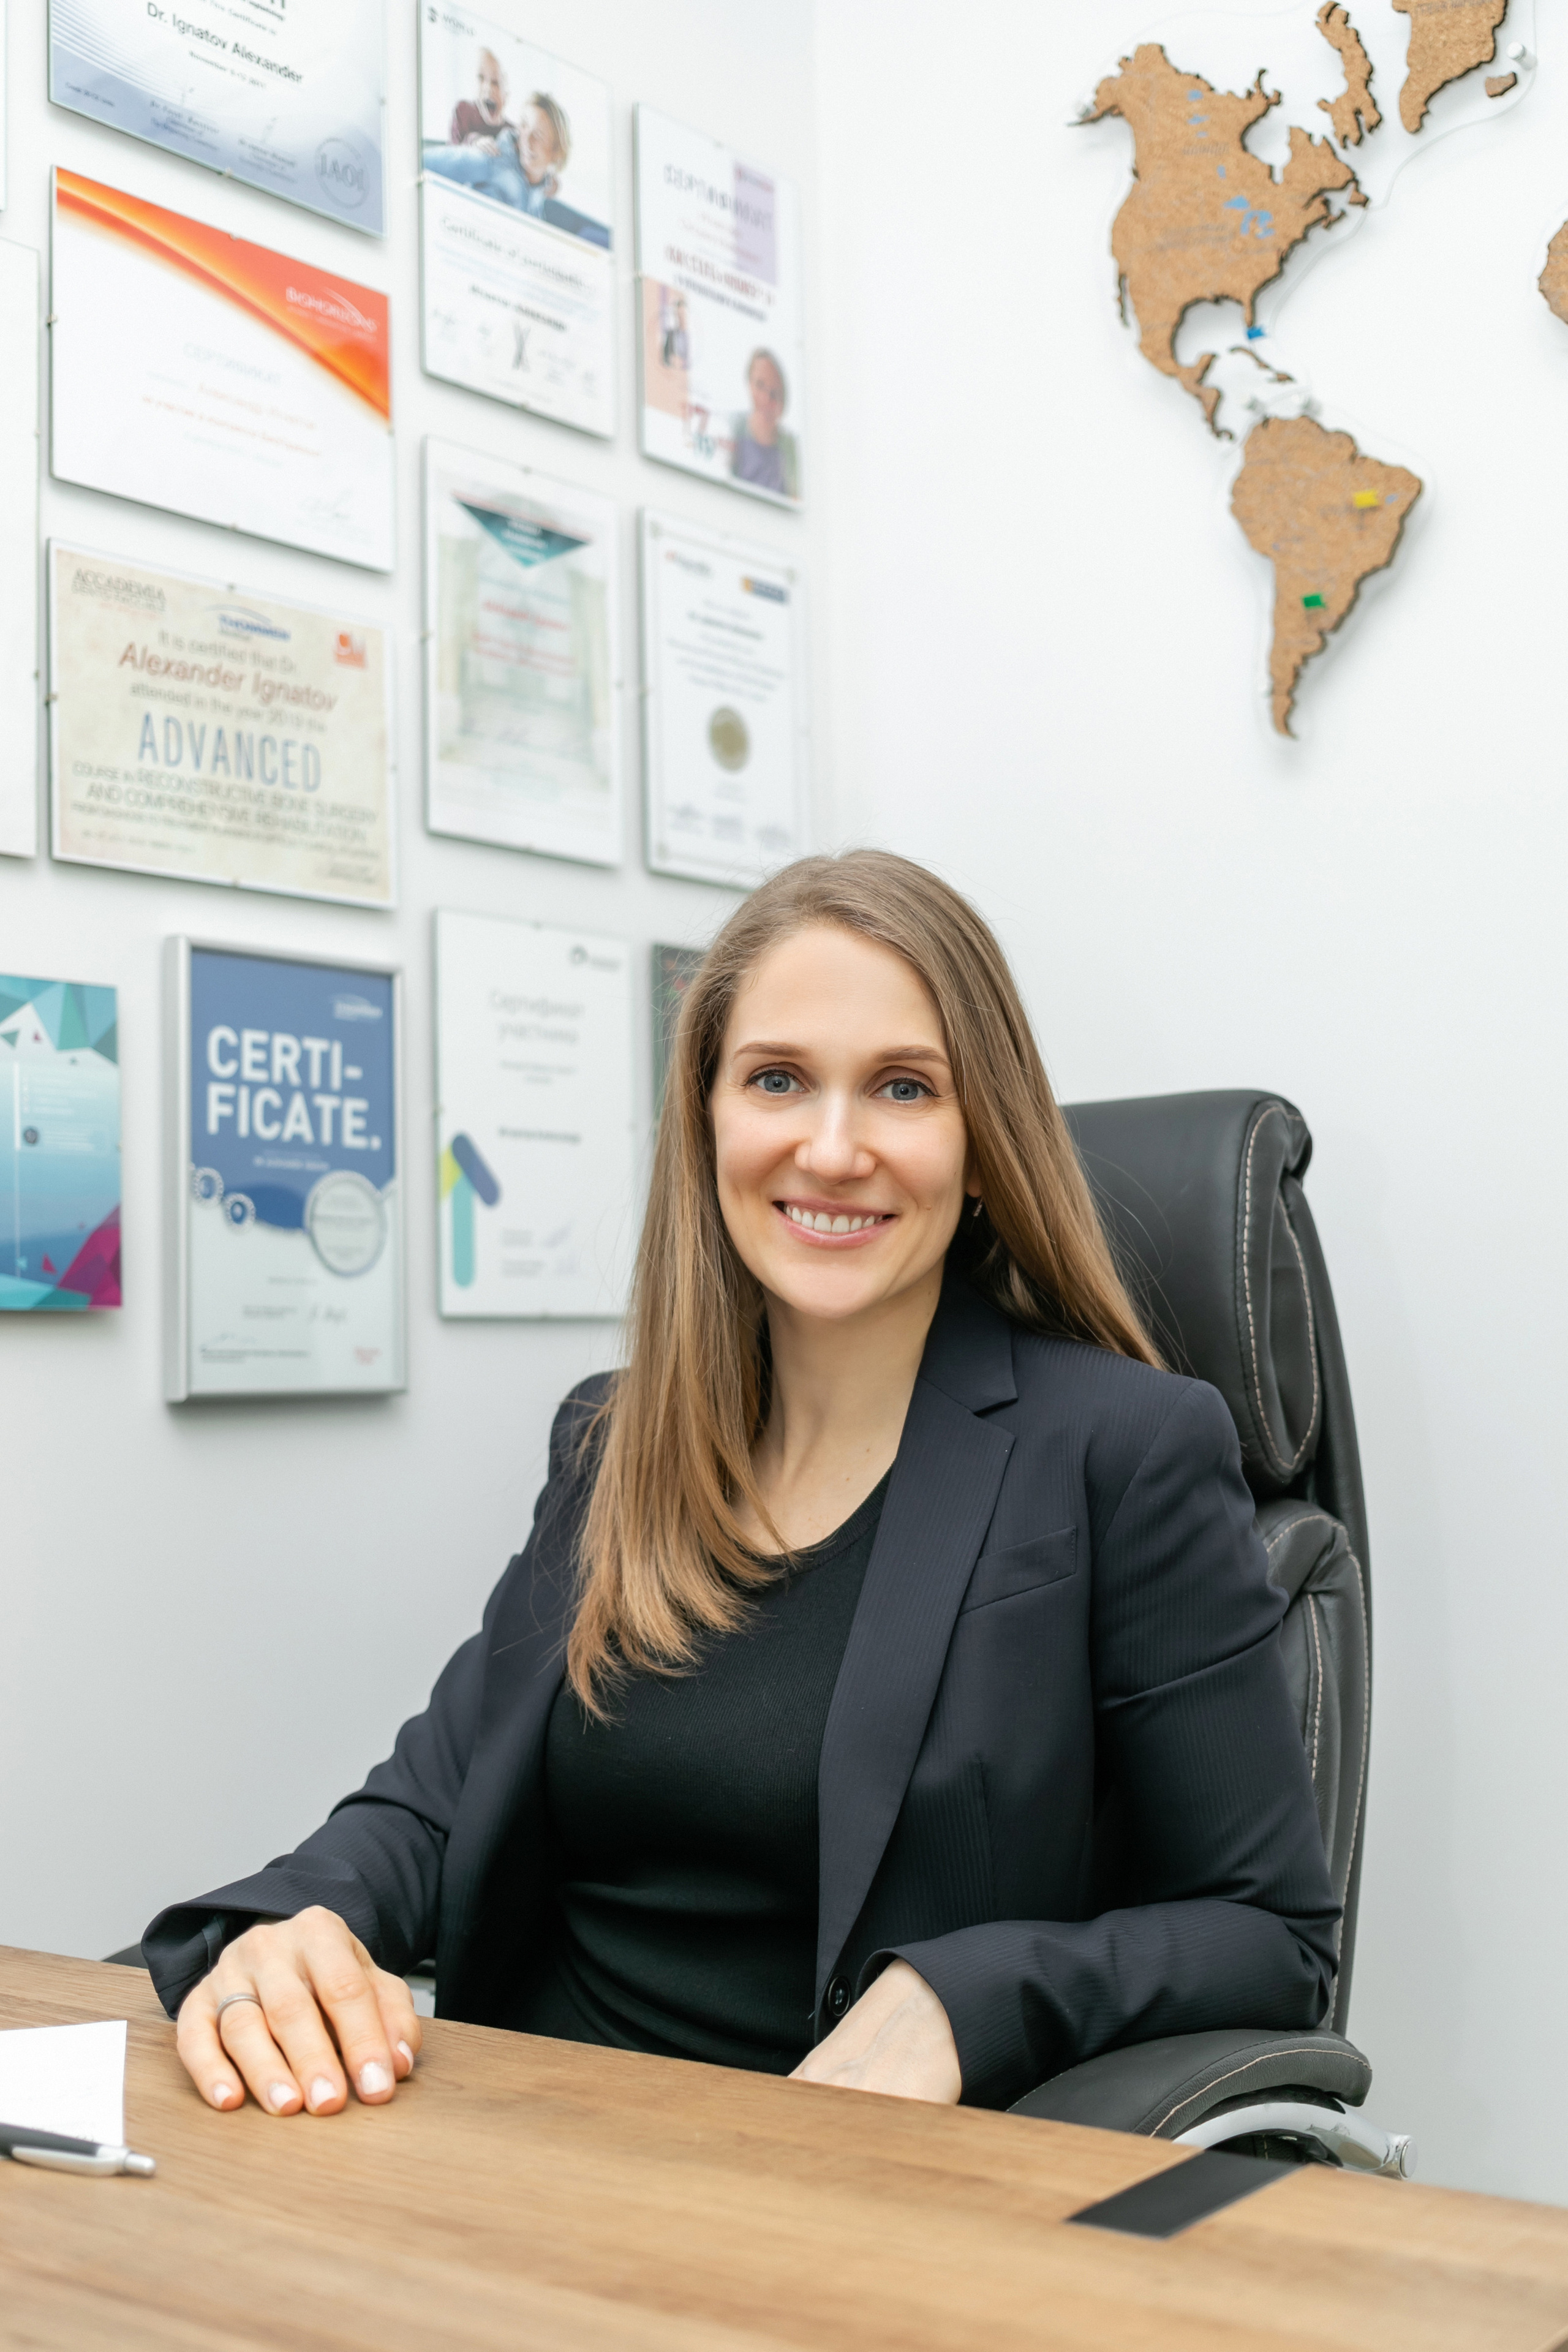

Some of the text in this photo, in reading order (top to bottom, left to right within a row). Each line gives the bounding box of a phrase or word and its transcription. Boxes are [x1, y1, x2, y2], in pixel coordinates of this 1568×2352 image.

[147, 1, 304, 85] Dr. Ignatov Alexander
[72, 568, 167, 604] ACCADEMIA
[117, 641, 339, 714] Alexander Ignatov
[158, 628, 169, 647] It
[173, 635, 184, 651] is
[187, 639, 247, 665] certified
[249, 647, 277, 671] that
[129, 682, 191, 707] attended
[194, 697, 207, 710] in
[209, 695, 233, 716] the
[235, 706, 263, 723] year
[137, 710, 322, 793] ADVANCED
[72, 760, 119, 781] COURSE
[137, 767, 265, 805] RECONSTRUCTIVE
[271, 790, 308, 813] BONE
[314, 797, 379, 824] SURGERY
[86, 782, 123, 805] AND
[124, 786, 249, 823] COMPREHENSIVE
[254, 809, 367, 844] REHABILITATION
[207, 1025, 364, 1091] CERTI-
[207, 1080, 382, 1152] FICATE.
